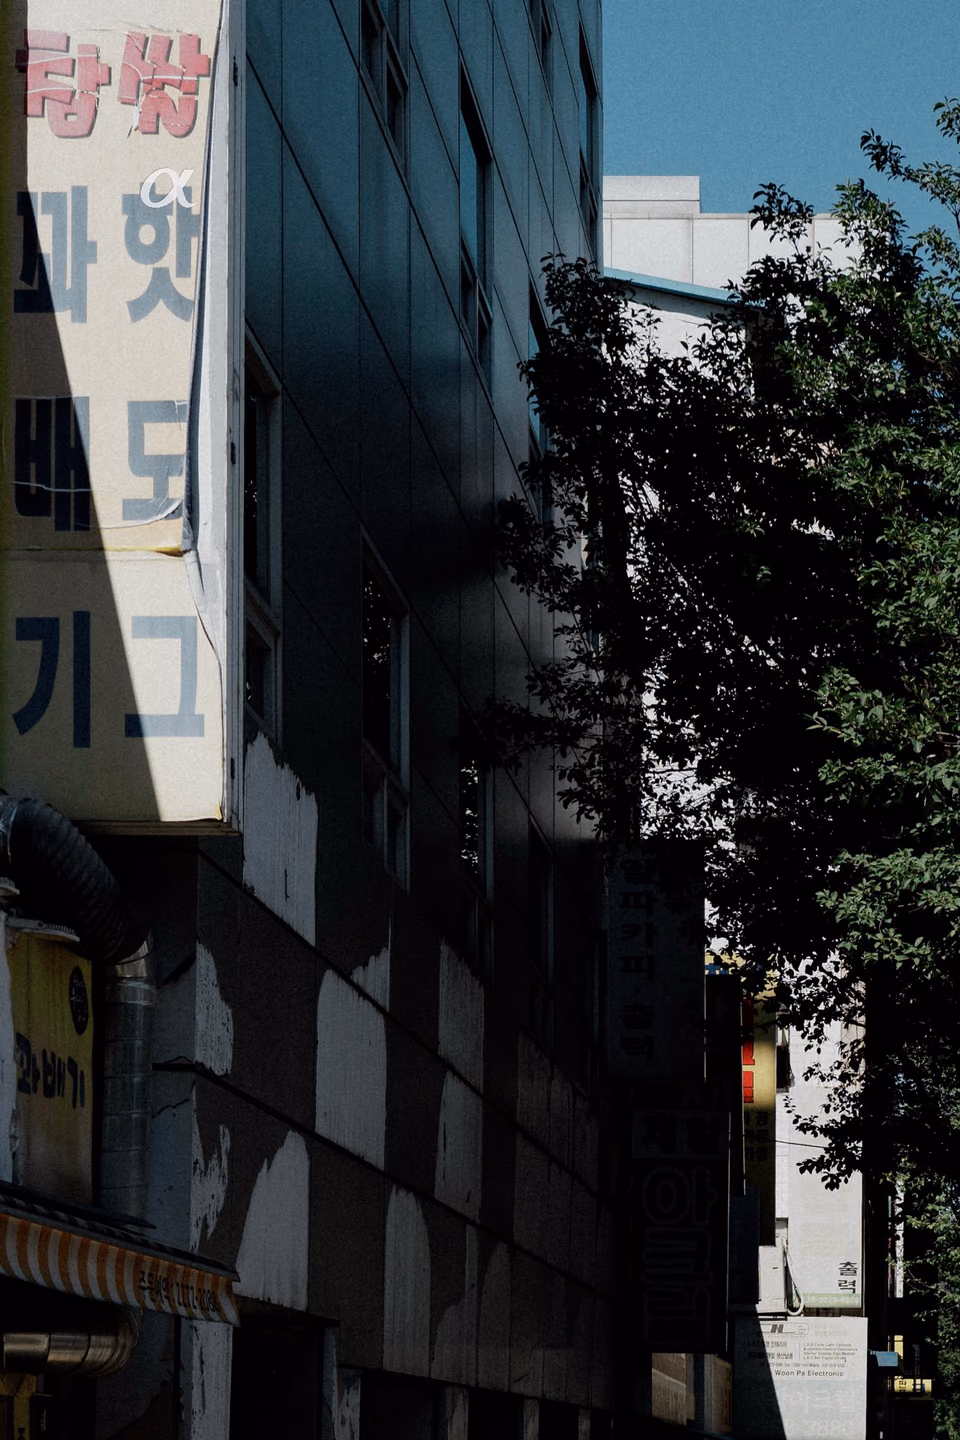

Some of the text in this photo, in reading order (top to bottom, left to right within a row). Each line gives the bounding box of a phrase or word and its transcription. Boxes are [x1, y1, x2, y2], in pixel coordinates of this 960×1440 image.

[13, 185, 97, 748] 꽈배기
[122, 182, 204, 737] 핫도그
[808, 1370, 844, 1378] Electronic
[838, 1261, 858, 1293] 출력
